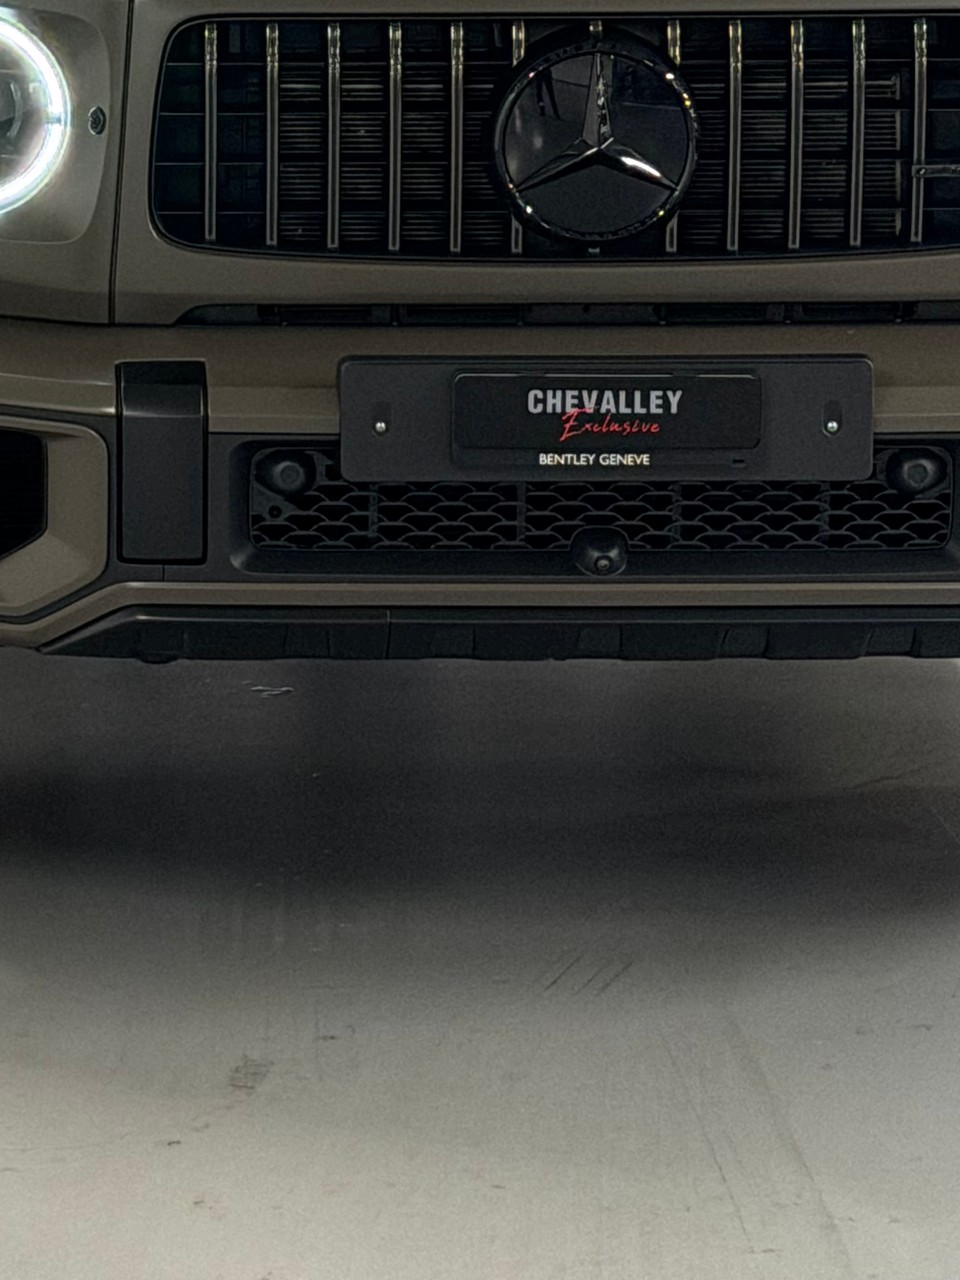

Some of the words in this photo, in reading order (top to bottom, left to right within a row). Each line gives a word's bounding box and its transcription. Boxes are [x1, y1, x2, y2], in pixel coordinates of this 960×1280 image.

[527, 389, 682, 414] CHEVALLEY
[559, 407, 660, 441] Exclusive
[539, 453, 596, 465] BENTLEY
[599, 453, 650, 465] GENEVE
